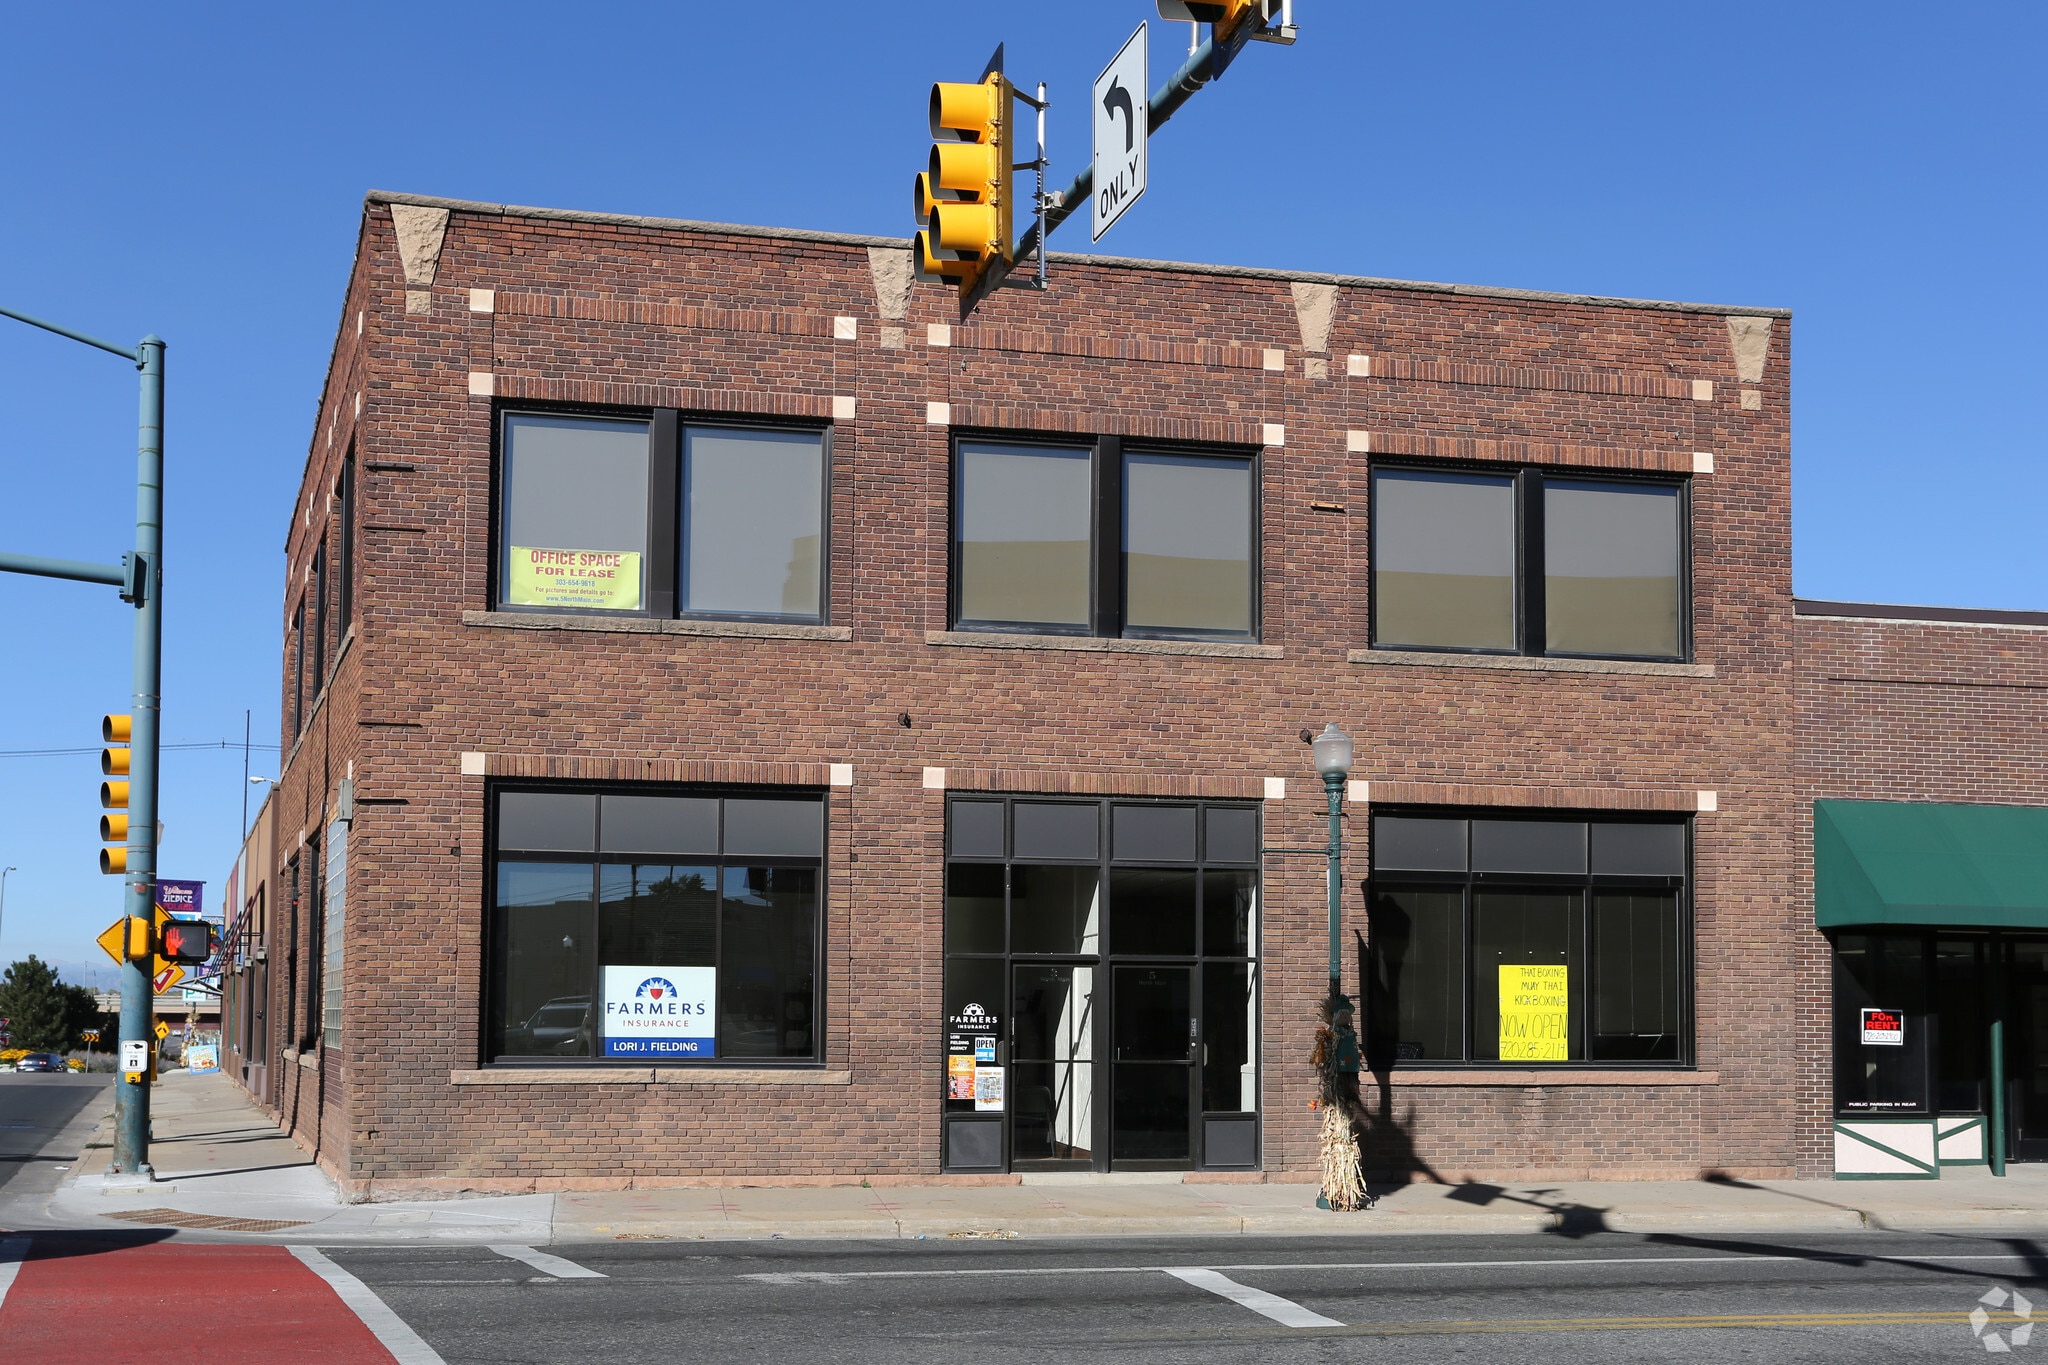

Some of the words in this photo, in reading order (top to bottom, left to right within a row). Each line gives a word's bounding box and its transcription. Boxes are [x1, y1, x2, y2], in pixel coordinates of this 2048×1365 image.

[1100, 154, 1138, 219] ONLY
[531, 550, 575, 566] OFFICE
[580, 553, 620, 567] SPACE
[536, 567, 565, 576] FOR
[570, 568, 615, 578] LEASE
[1520, 968, 1536, 977] THAI
[1537, 968, 1565, 978] BOXING
[1521, 981, 1539, 991] MUAY
[1544, 981, 1563, 991] THAI
[607, 1002, 706, 1015] FARMERS
[623, 1020, 689, 1028] INSURANCE
[950, 1016, 998, 1024] FARMERS
[1500, 1014, 1529, 1039] NOW
[1532, 1013, 1568, 1039] OPEN
[1866, 1021, 1899, 1030] RENT
[613, 1042, 638, 1051] LORI
[640, 1042, 648, 1051] J.
[651, 1042, 698, 1051] FIELDING
[976, 1039, 994, 1049] OPEN
